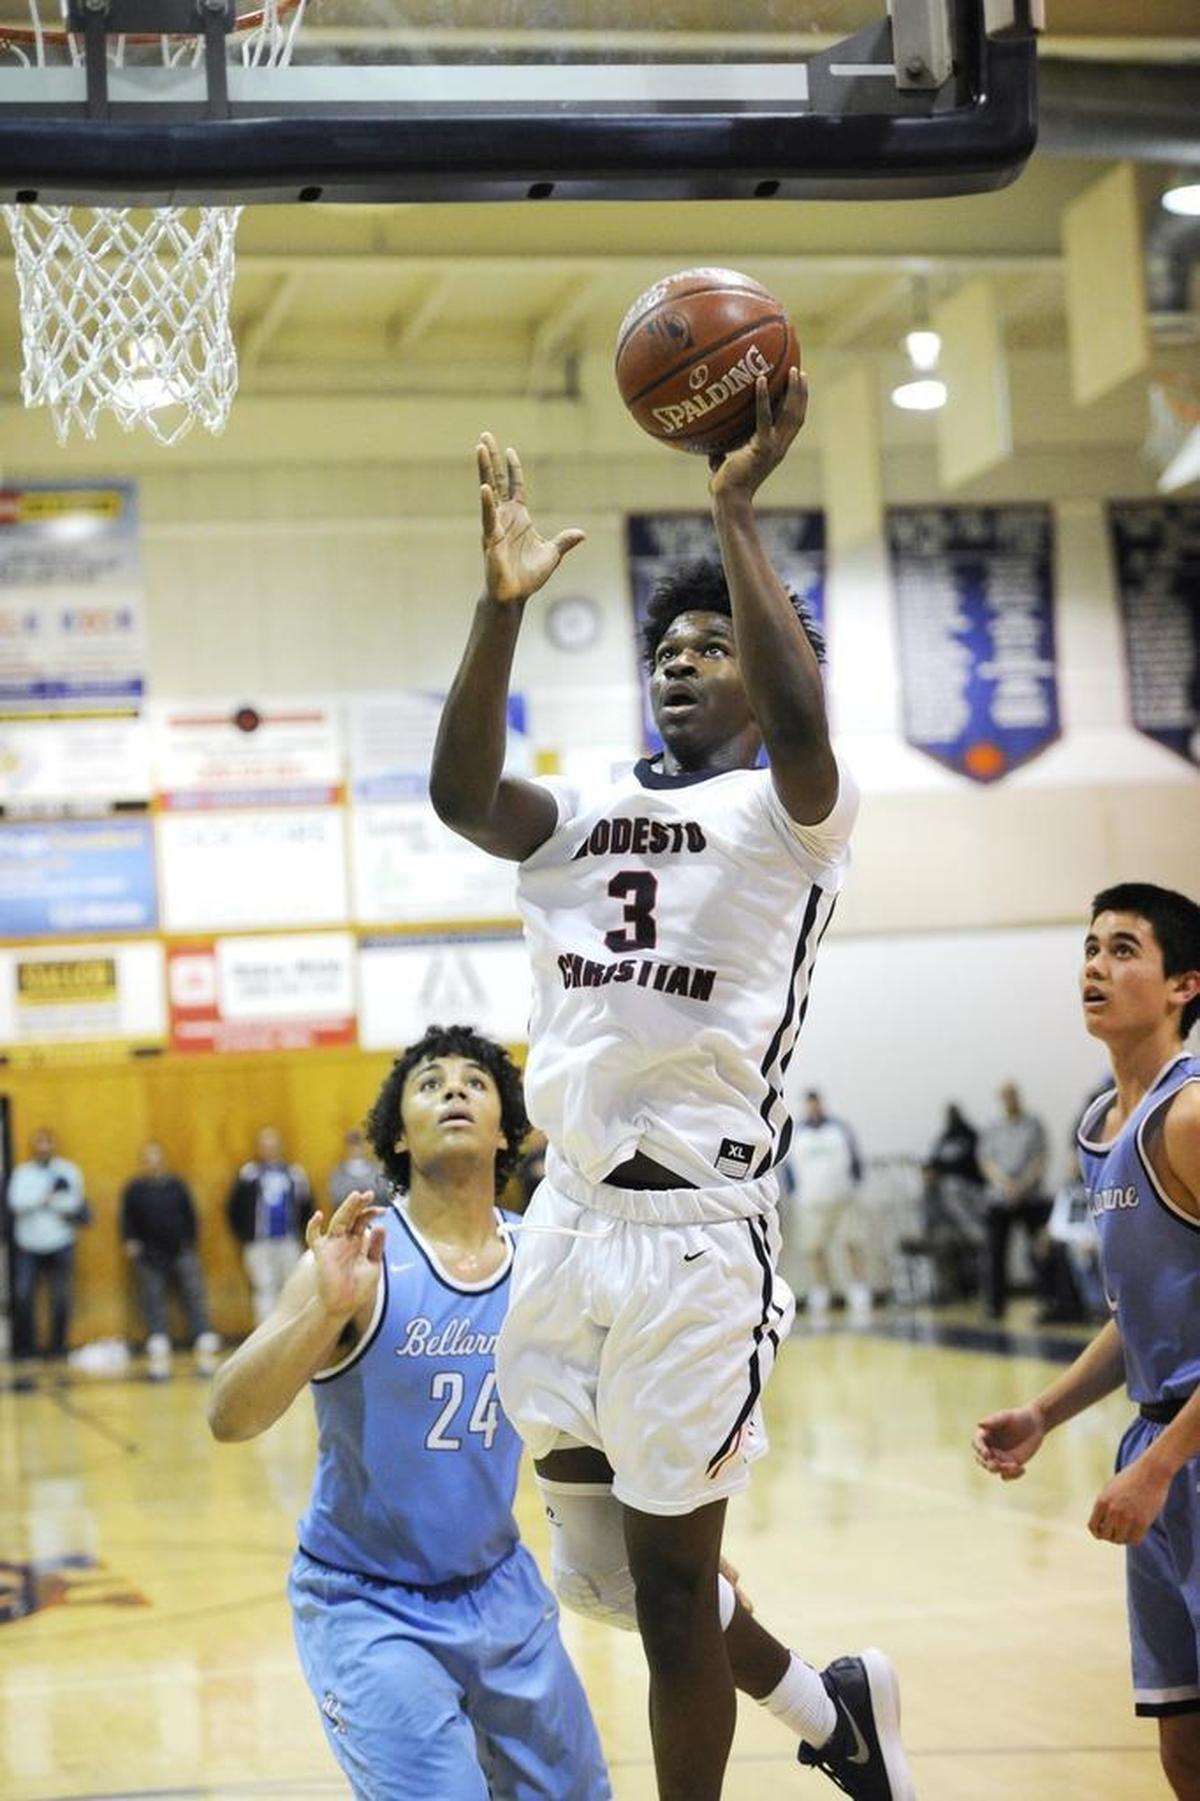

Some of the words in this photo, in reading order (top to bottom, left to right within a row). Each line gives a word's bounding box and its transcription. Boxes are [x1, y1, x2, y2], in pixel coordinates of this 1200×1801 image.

[652, 345, 774, 433] SPALDING
[604, 870, 658, 952] 3
[728, 1145, 746, 1158] XL
[426, 1372, 499, 1450] 24
